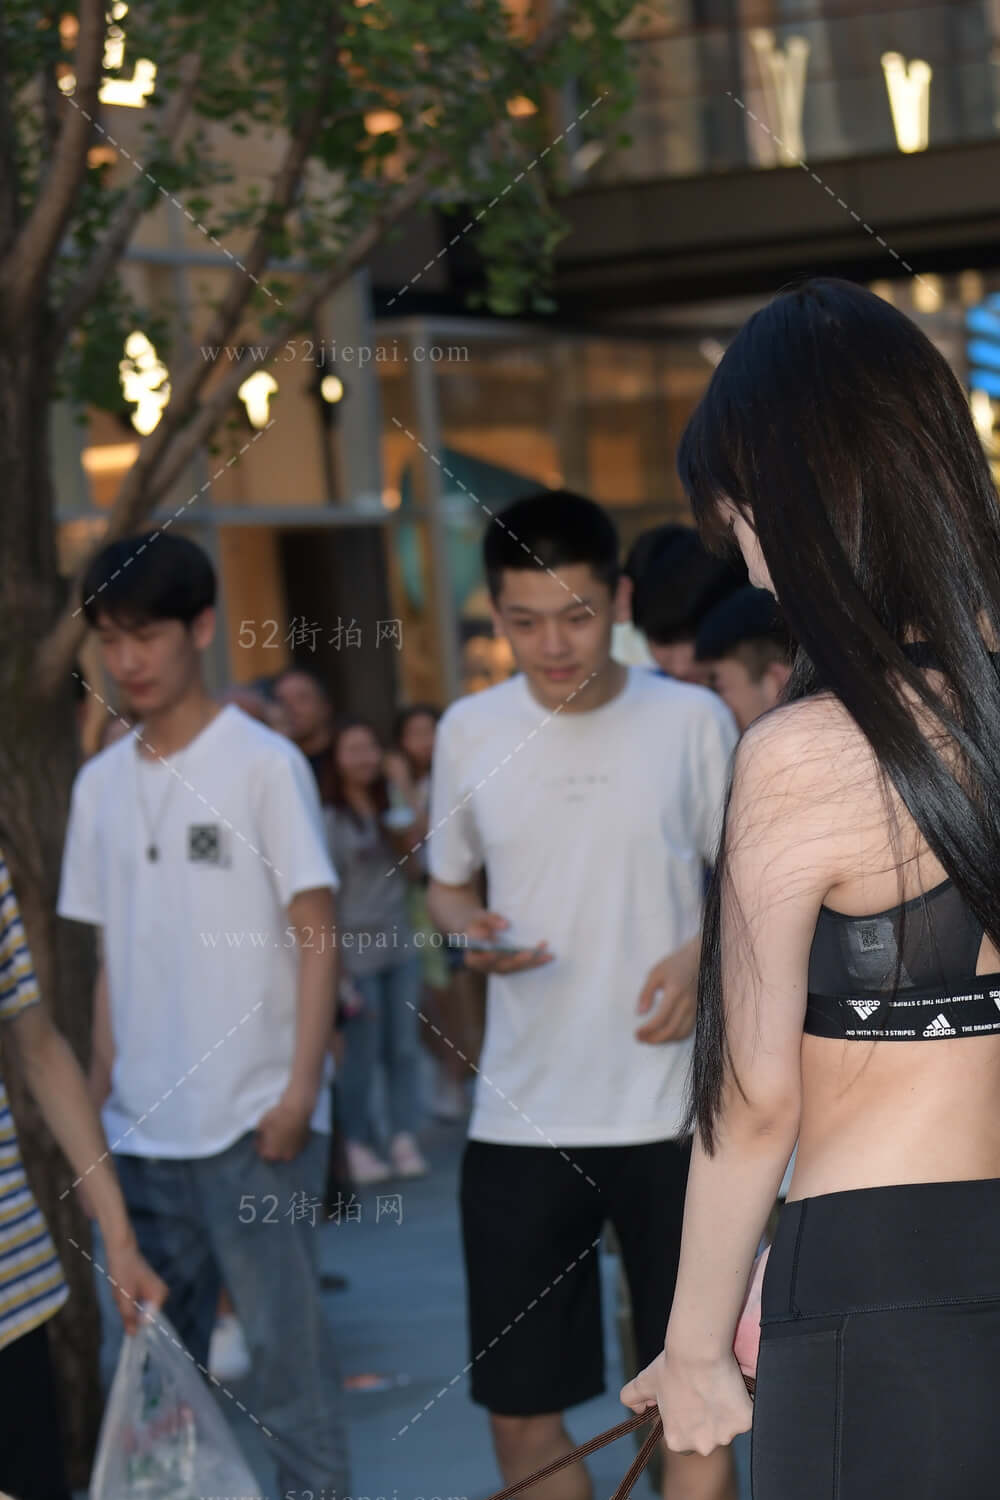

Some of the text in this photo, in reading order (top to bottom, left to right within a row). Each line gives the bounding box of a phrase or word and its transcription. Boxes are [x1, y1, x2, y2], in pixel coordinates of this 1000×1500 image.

[952, 994, 972, 1002] BRAND
[974, 1023, 992, 1031] BRAND
[922, 1027, 956, 1037] adidas
